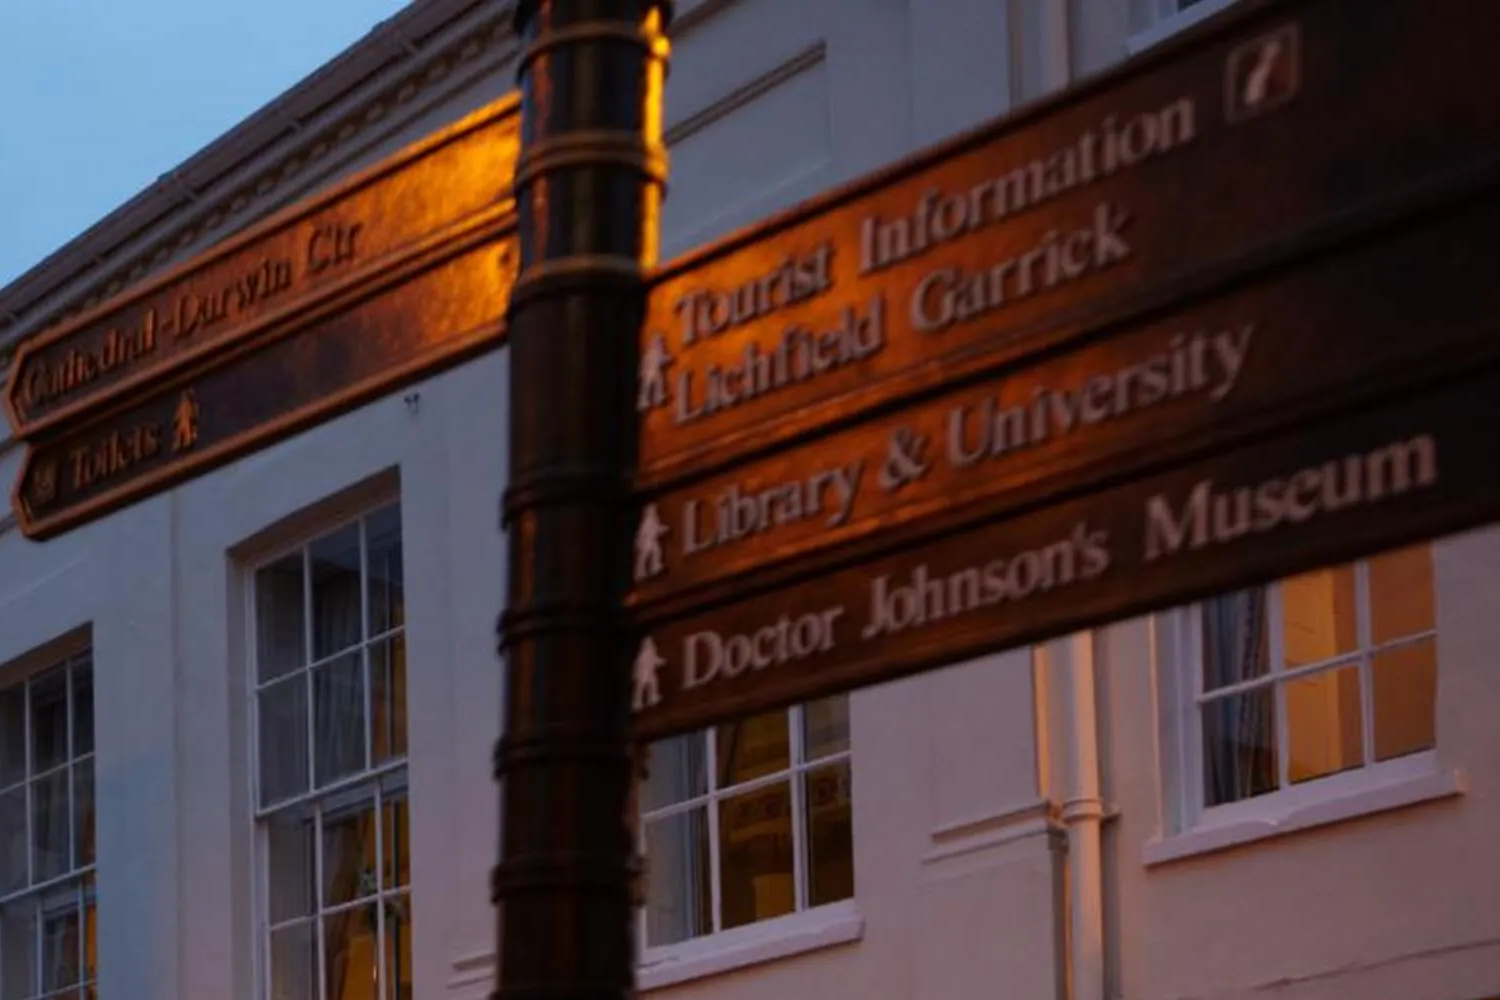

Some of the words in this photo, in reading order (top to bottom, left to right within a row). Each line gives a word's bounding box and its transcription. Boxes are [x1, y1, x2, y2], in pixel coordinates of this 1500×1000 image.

[673, 239, 833, 347] Tourist
[856, 93, 1196, 275] Information
[675, 290, 888, 425] Lichfield
[909, 201, 1133, 332] Garrick
[681, 455, 864, 558] Library
[877, 424, 930, 493] &
[946, 320, 1257, 470] University
[681, 604, 844, 692] Doctor
[861, 520, 1112, 638] Johnson's
[1141, 431, 1440, 561] Museum
